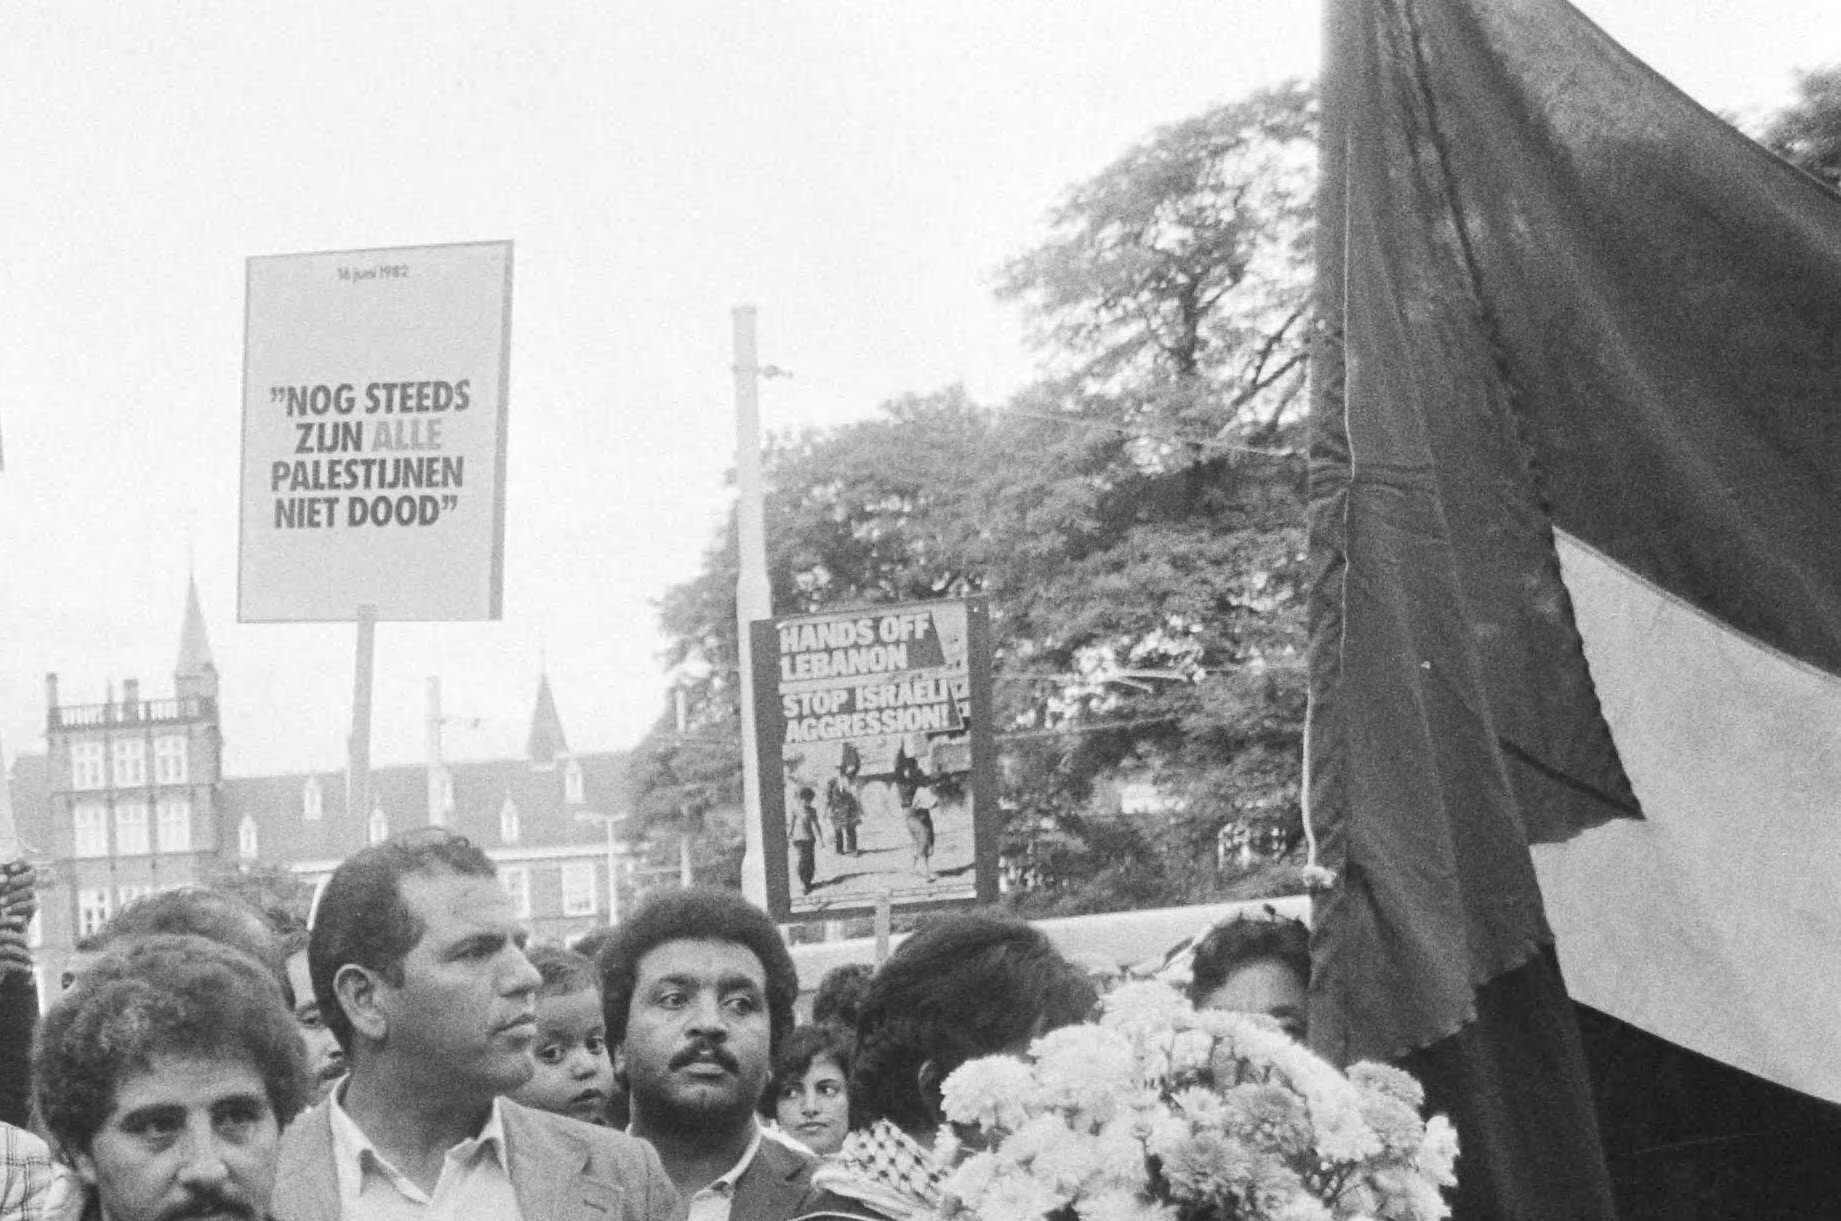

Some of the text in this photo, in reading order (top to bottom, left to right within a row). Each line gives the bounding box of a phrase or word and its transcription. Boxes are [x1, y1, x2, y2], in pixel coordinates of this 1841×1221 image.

[365, 379, 471, 415] STEEDS
[295, 418, 443, 454] ZIJN ALLE
[271, 456, 465, 492] PALESTIJNEN
[274, 497, 340, 529] NIET
[780, 612, 930, 654] HANDS OFF
[780, 642, 908, 682] LEBANON
[782, 679, 949, 718] STOP ISRAELI
[785, 703, 950, 744] AGGRESSION!
